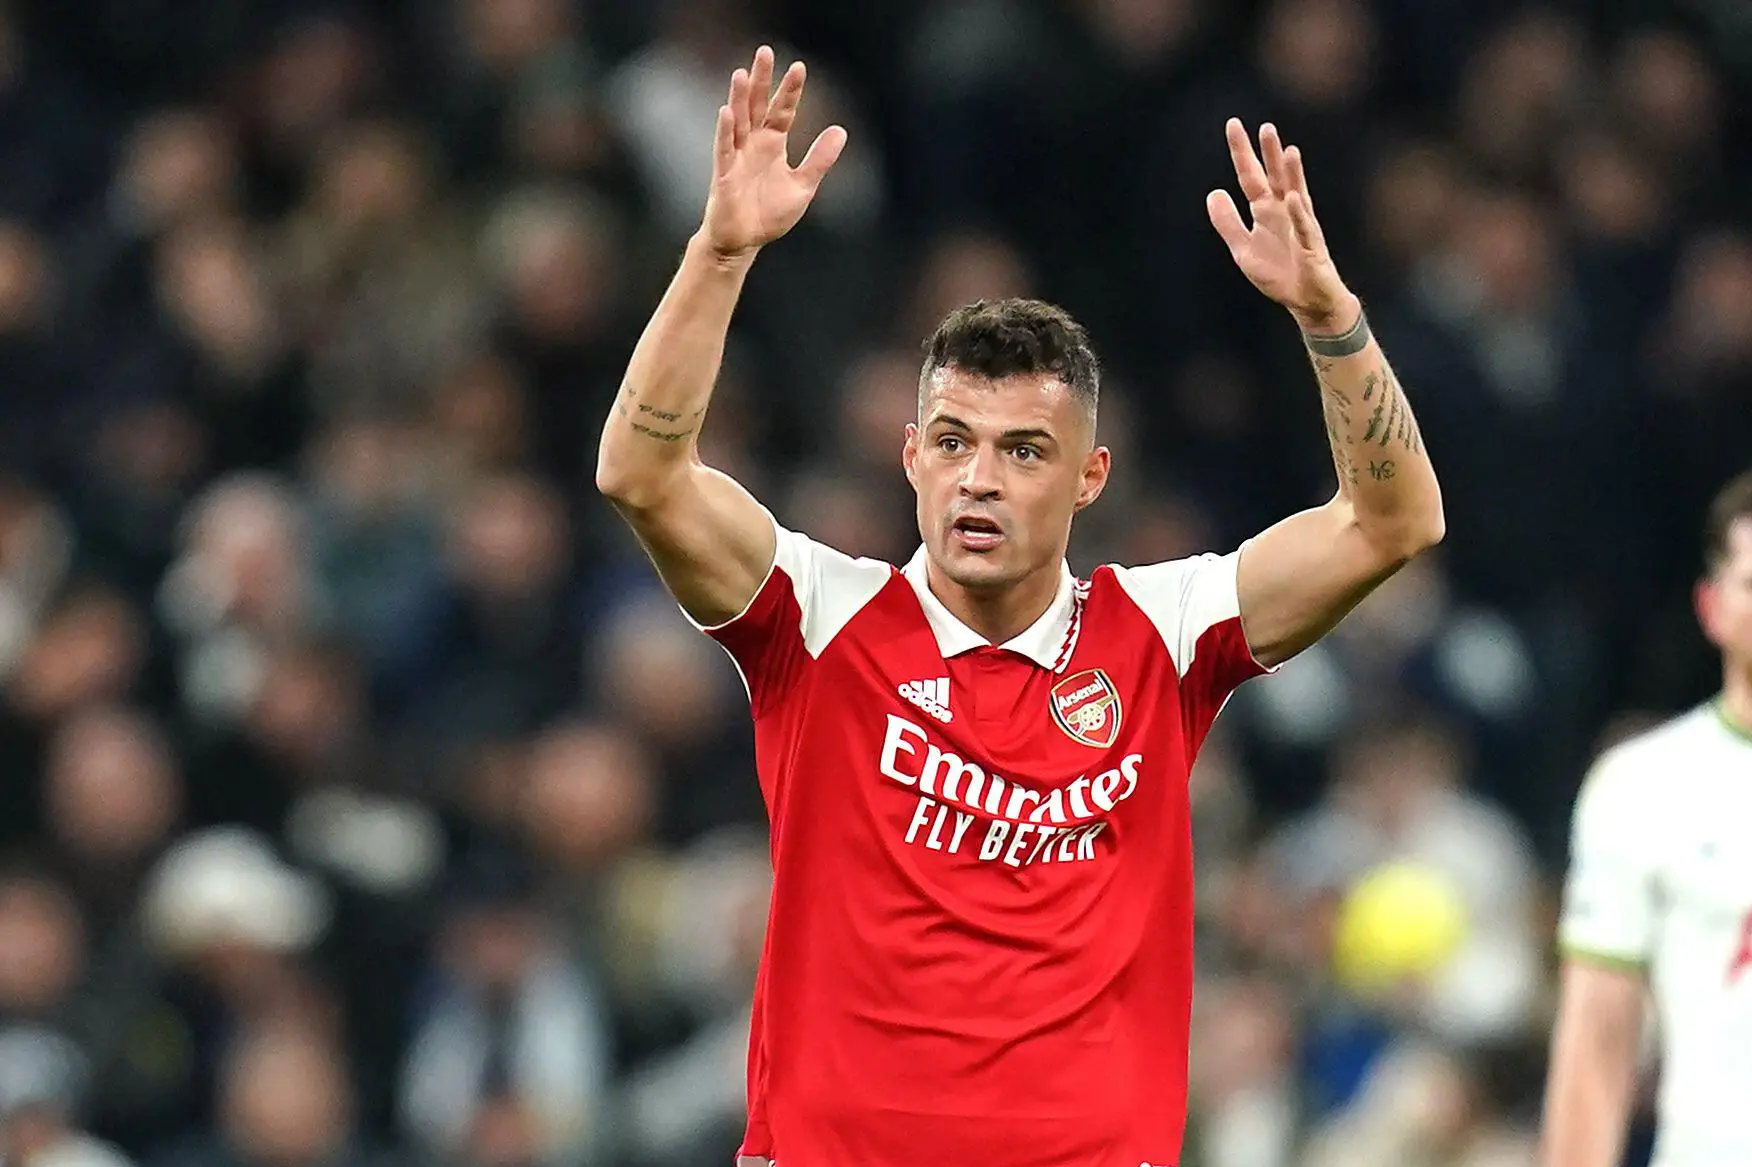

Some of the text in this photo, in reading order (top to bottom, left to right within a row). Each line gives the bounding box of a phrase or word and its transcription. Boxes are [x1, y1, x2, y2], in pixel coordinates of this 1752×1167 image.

[880, 712, 1143, 824] Emirates
[904, 796, 1109, 868] FLY BETTER
